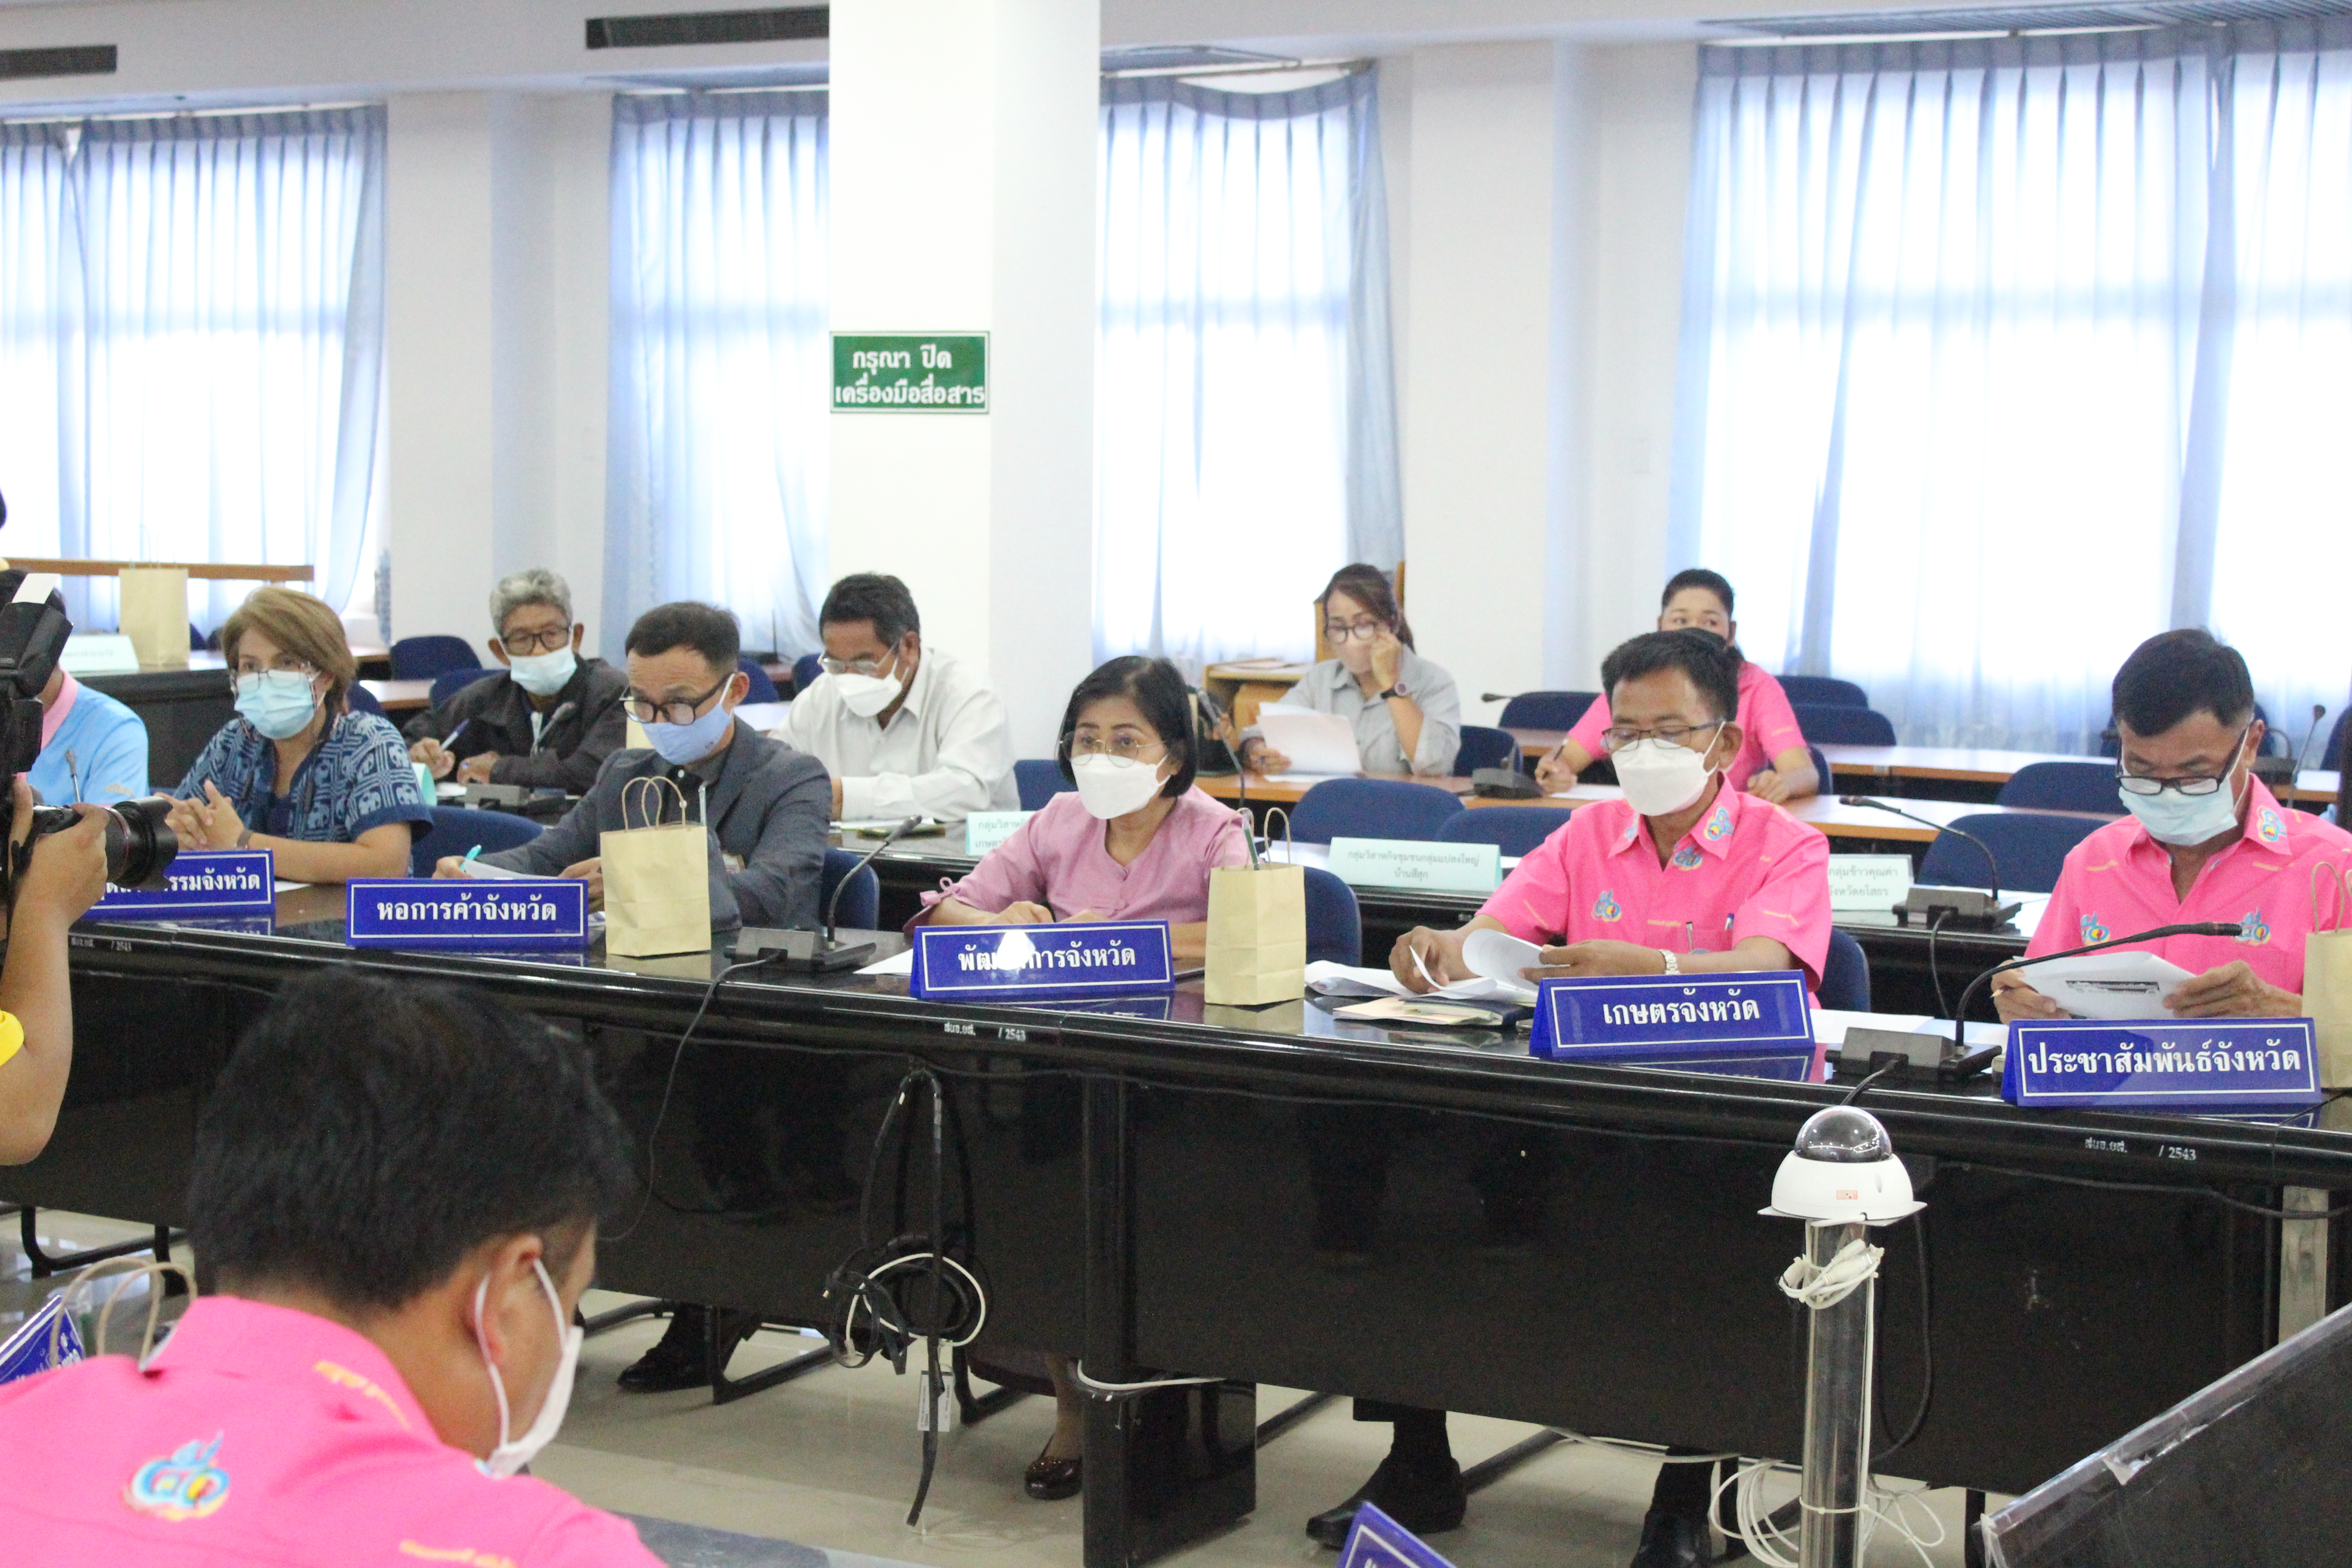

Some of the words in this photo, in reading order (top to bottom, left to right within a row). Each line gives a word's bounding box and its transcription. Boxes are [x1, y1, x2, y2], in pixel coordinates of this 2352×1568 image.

[853, 351, 911, 375] กรุณา
[920, 343, 952, 368] ปิด
[835, 372, 984, 404] เครื่องมือสื่อสาร
[377, 892, 557, 921] หอการค้าจังหวัด
[958, 939, 1136, 971] พัฒการจังหวัด
[1602, 988, 1761, 1025] เกษตรจังหวัด
[2028, 1039, 2301, 1074] ประชาสัมพันธ์จังหวัด
[2168, 1147, 2196, 1161] 2543
